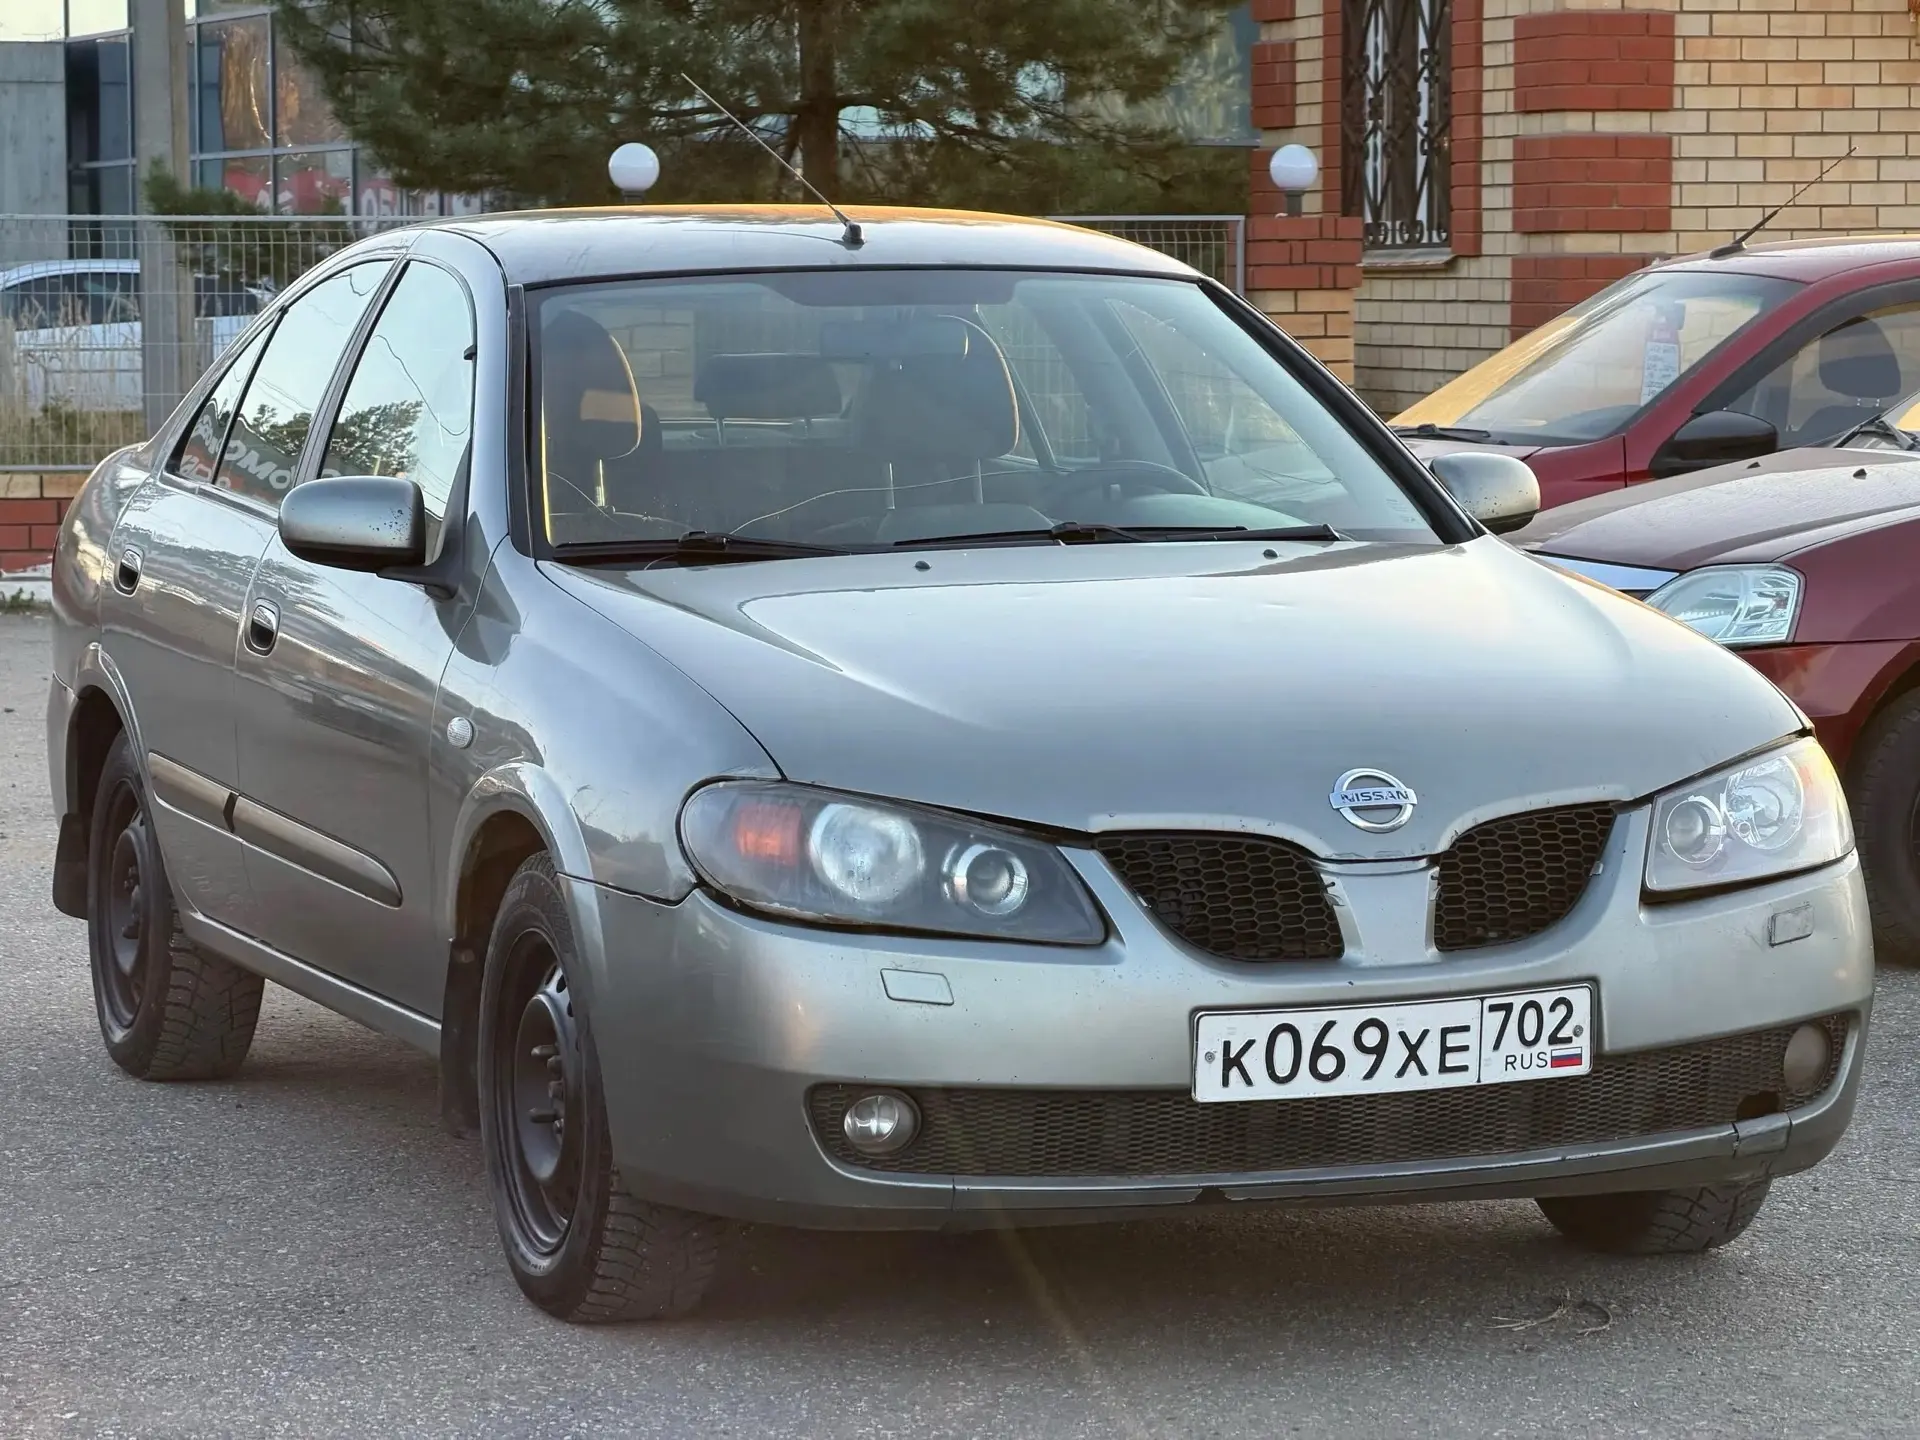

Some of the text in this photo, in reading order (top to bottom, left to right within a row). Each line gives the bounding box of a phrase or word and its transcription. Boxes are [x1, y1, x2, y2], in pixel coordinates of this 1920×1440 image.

[1340, 790, 1409, 803] NISSAN
[1487, 996, 1574, 1052] 702
[1503, 1052, 1549, 1072] RUS
